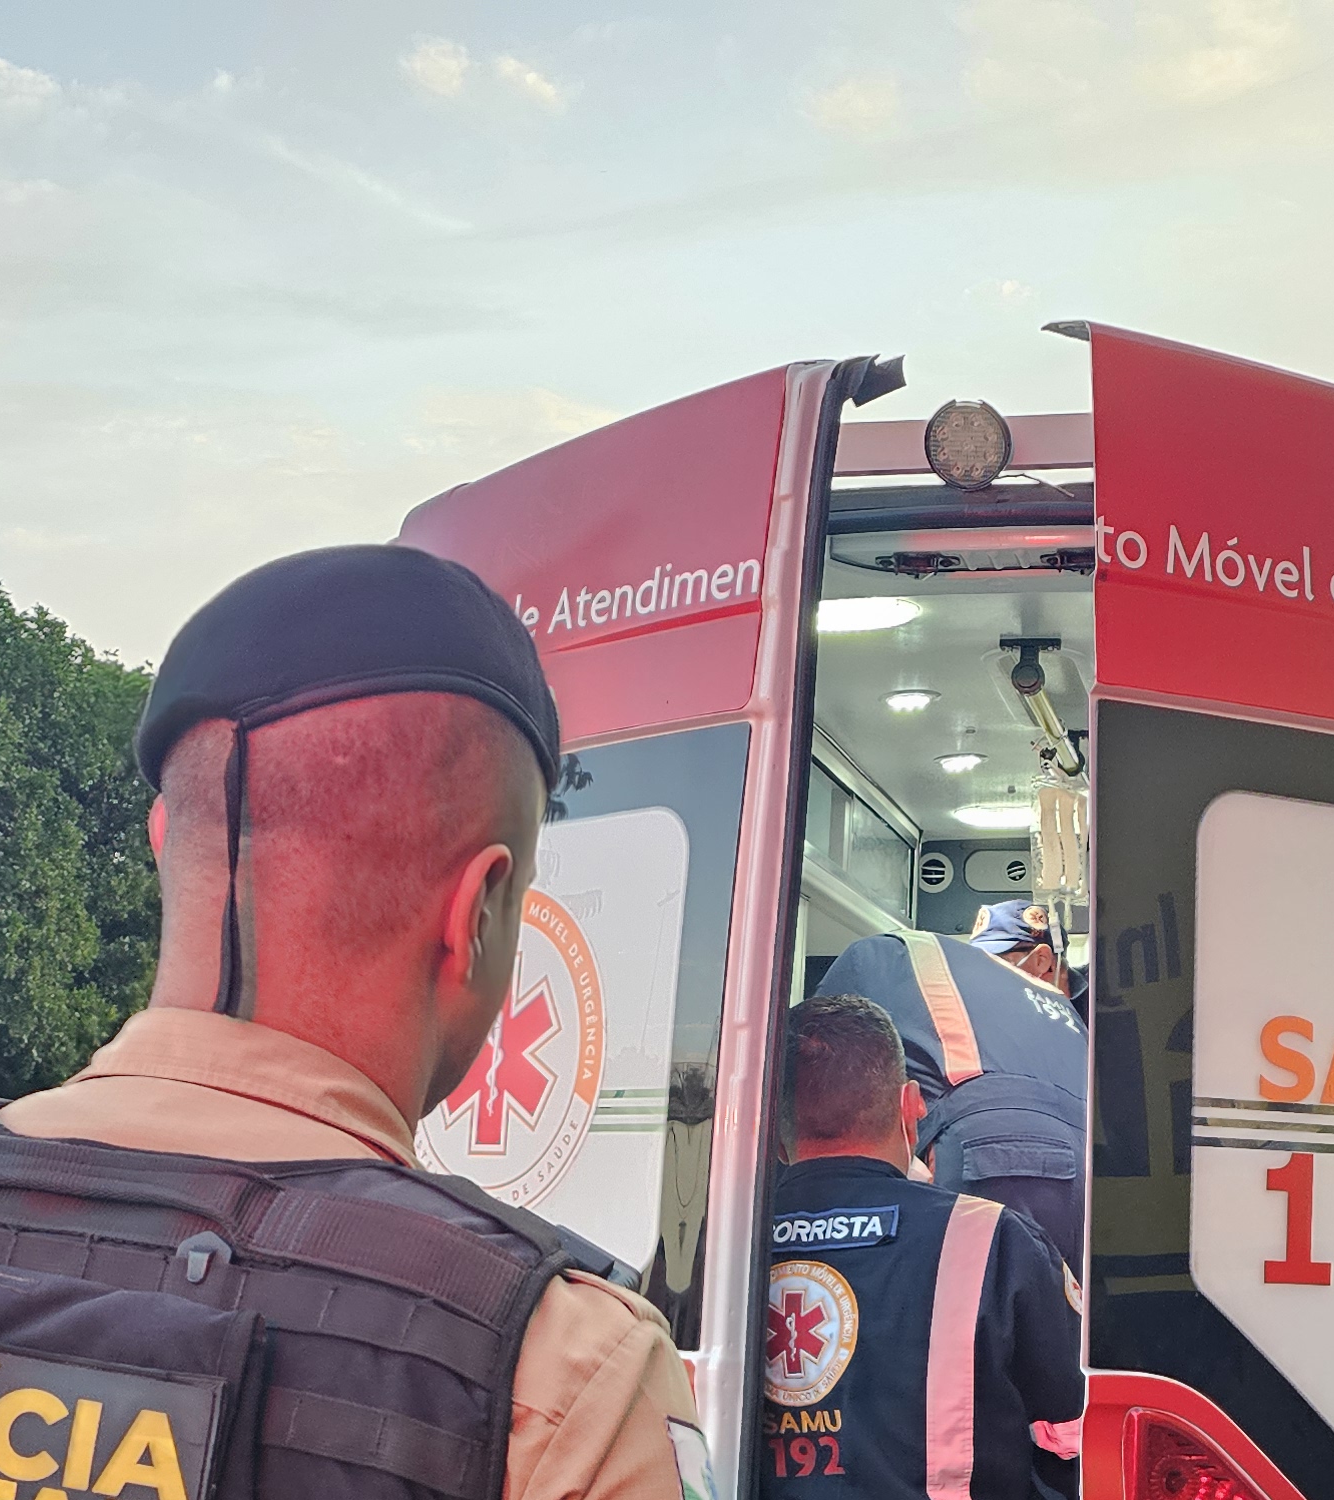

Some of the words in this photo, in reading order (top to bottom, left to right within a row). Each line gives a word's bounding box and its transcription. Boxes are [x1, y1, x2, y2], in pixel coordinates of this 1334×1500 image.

[1166, 524, 1315, 602] Móvel
[547, 558, 761, 634] Atendimen
[528, 901, 569, 944] MÓVEL
[568, 942, 584, 969] DE
[578, 971, 599, 1080] URGÊNCIA
[1033, 999, 1081, 1035] 192
[511, 1183, 531, 1202] DE
[773, 1216, 883, 1244] ORRISTA
[768, 1436, 846, 1479] 192
